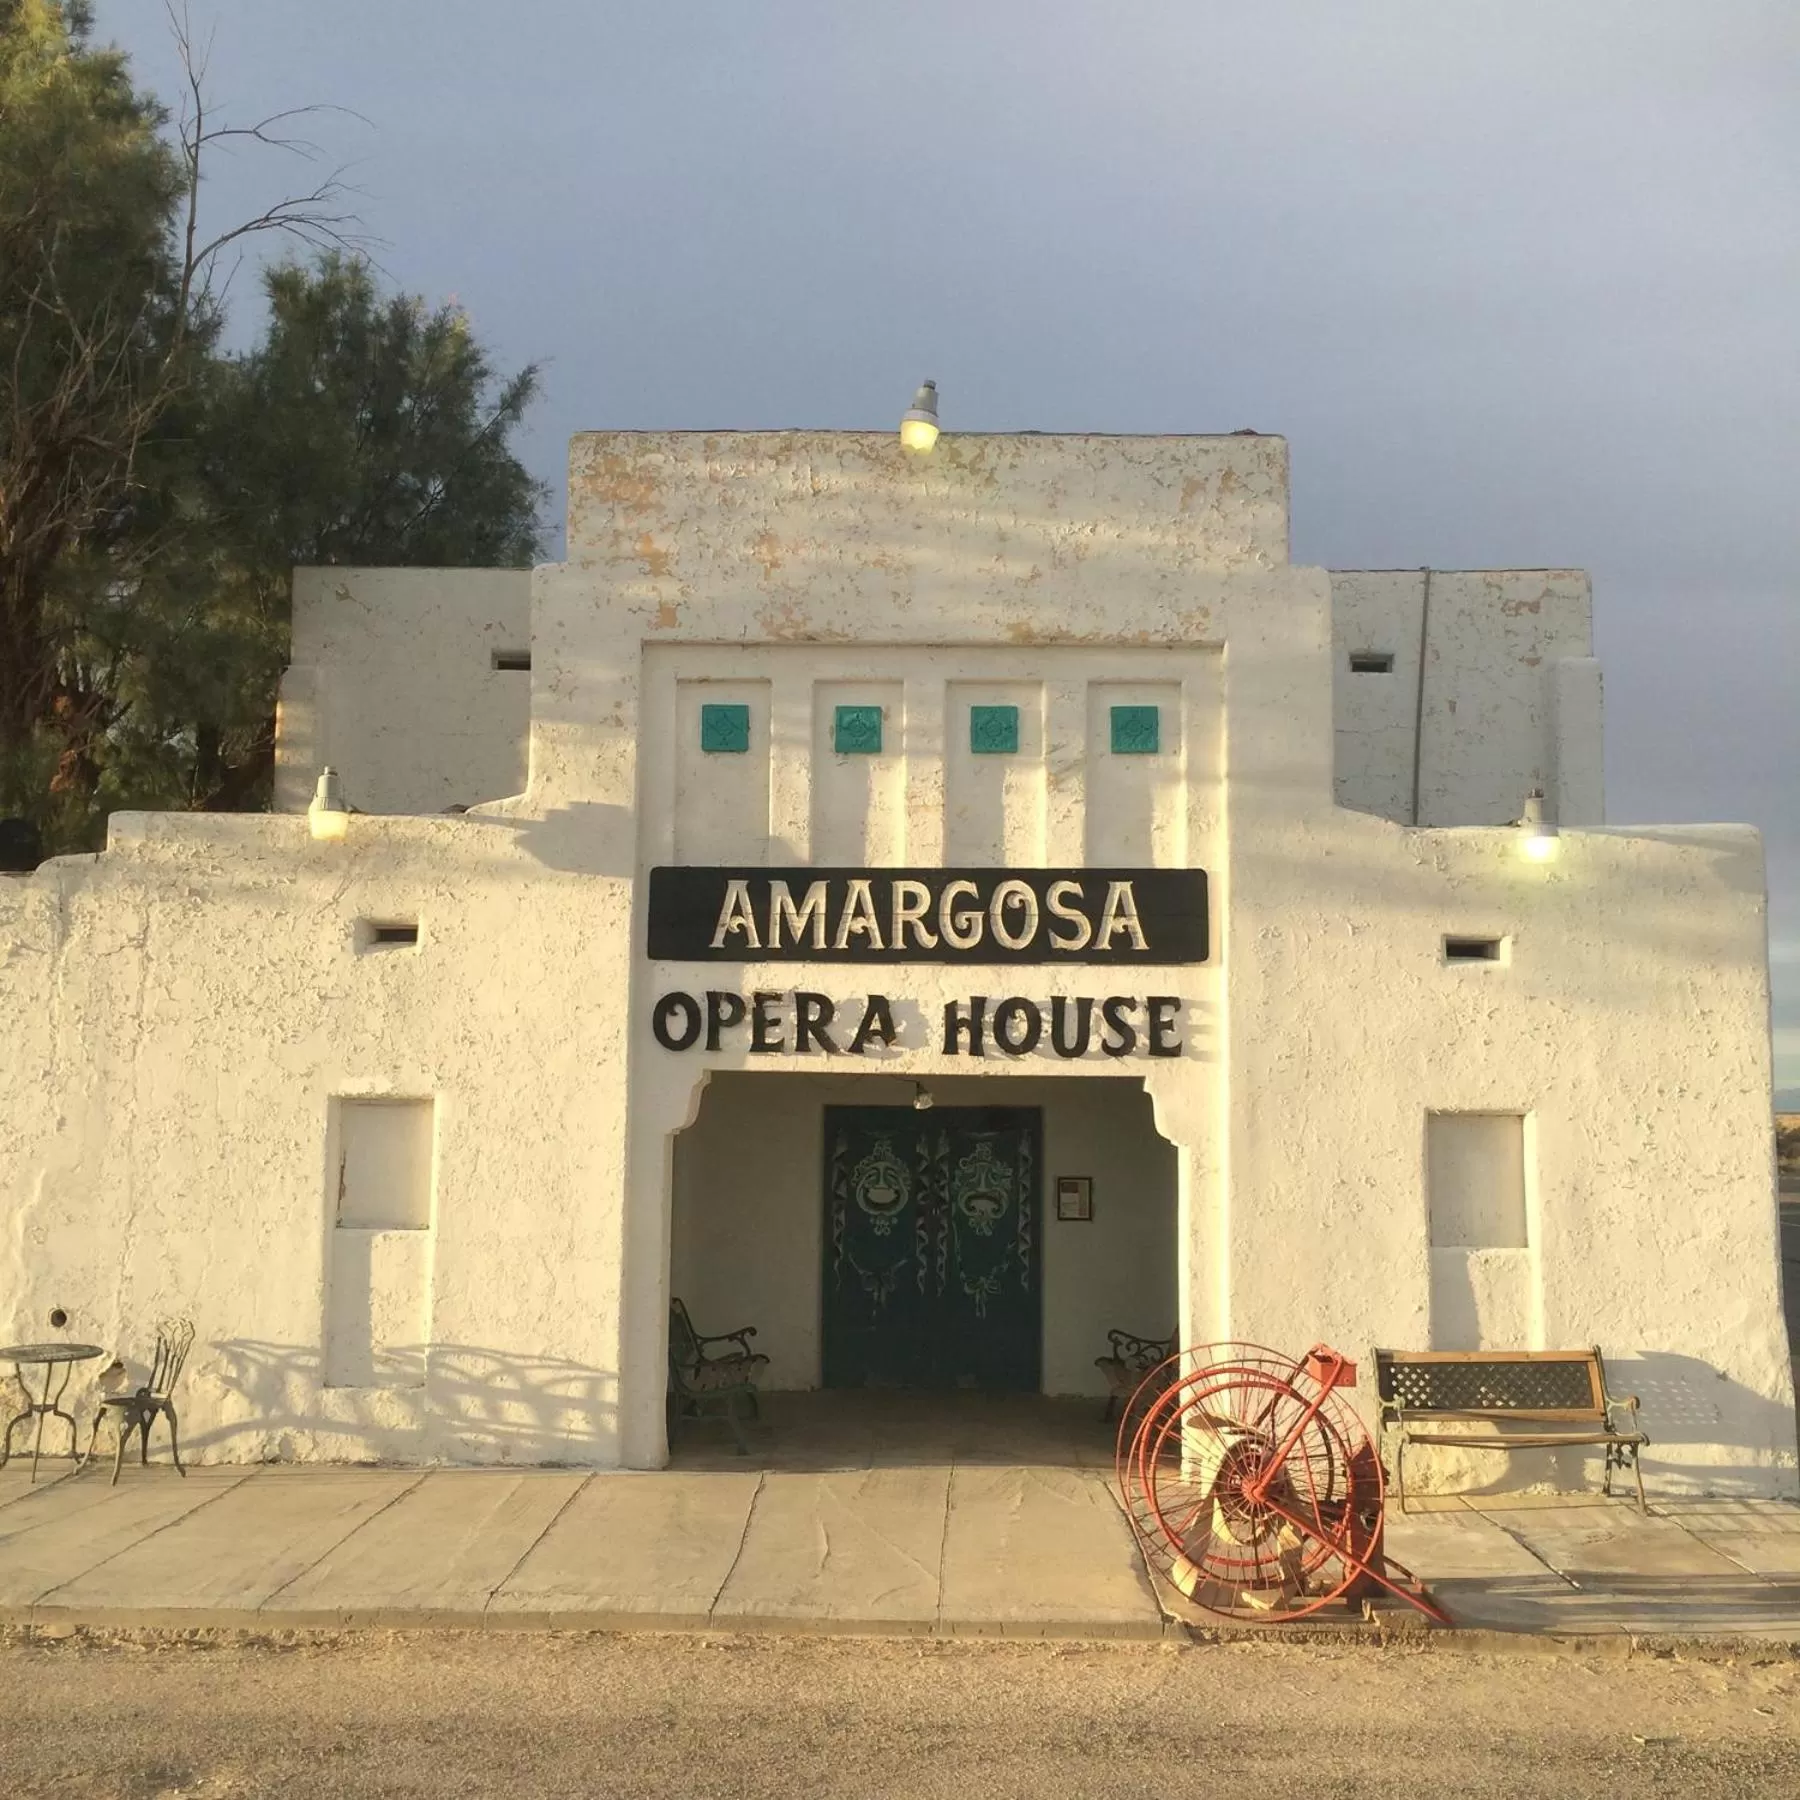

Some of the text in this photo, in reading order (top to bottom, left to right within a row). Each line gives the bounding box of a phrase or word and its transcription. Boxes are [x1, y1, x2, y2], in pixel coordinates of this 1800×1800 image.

[709, 879, 1150, 951] AMARGOSA
[652, 990, 1183, 1058] OPERA HOUSE
